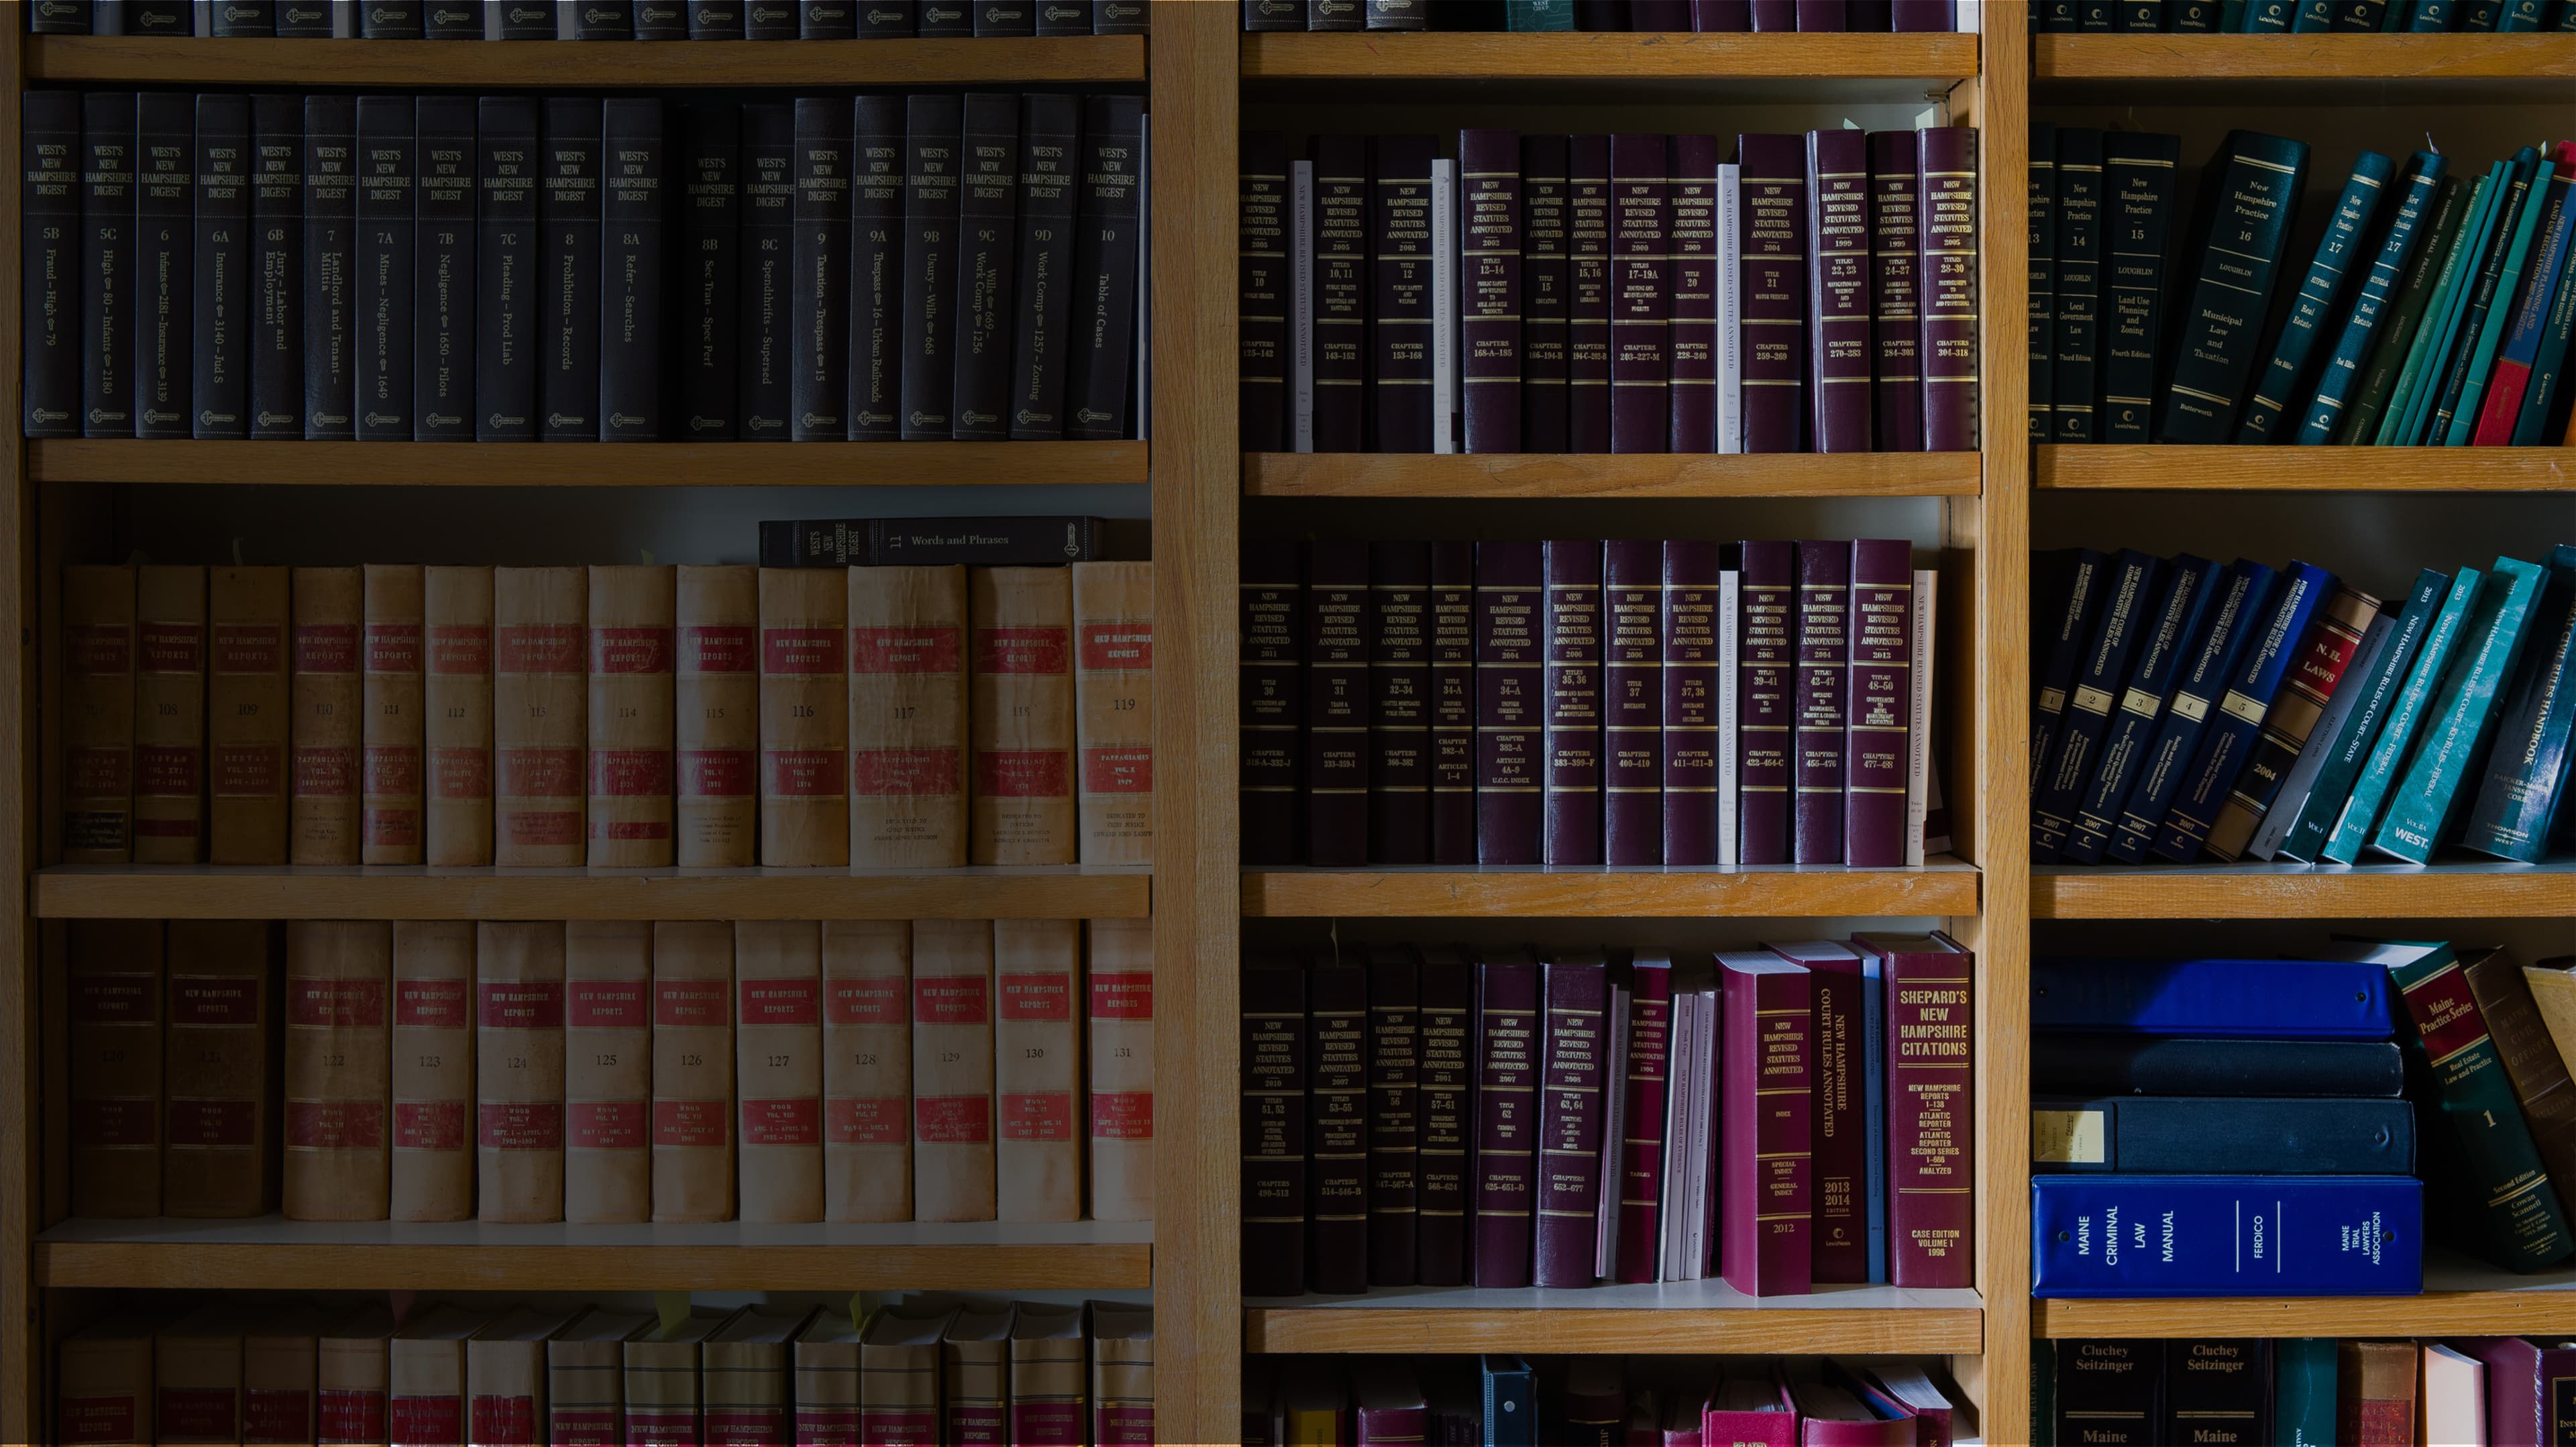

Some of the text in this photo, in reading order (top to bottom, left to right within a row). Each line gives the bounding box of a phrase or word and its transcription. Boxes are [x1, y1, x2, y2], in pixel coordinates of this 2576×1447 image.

[1099, 147, 1128, 159] WEST'S
[1103, 161, 1121, 171] NEW
[1088, 173, 1135, 186] HAMPSHIRE
[2132, 178, 2148, 188] New
[1095, 186, 1125, 198] DIGEST
[1764, 187, 1781, 195] NEW
[2249, 181, 2269, 192] New
[1751, 198, 1793, 206] HAMPSHIRE
[2121, 191, 2158, 203] Hampshire
[2234, 191, 2277, 208] Hampshire
[1758, 209, 1788, 217] REVISED
[2125, 205, 2152, 215] Practice
[2235, 205, 2269, 220] Practice
[1755, 220, 1790, 228] STATUTES
[268, 229, 284, 242] 6B
[501, 233, 516, 246] 7C
[1100, 230, 1115, 242] 10
[1751, 231, 1793, 239] ANNOTATED
[2131, 229, 2144, 239] 15
[2239, 230, 2251, 242] 16
[2328, 242, 2343, 253] 17
[2387, 242, 2402, 252] 17
[2118, 267, 2153, 276] LOUGHLIN
[2219, 263, 2253, 276] LOUGHLIN
[2527, 215, 2565, 329] NEW HAMPSHIRE PLANNING AND
[264, 252, 276, 325] Employment
[1767, 278, 1776, 287] 21
[275, 251, 286, 350] Jury Labor and
[2118, 296, 2150, 306] Land Use
[501, 255, 513, 365] Pleading Prod Liab
[1095, 274, 1109, 348] Table of Cases
[2118, 306, 2149, 317] Planning
[2361, 303, 2375, 315] Real
[2126, 316, 2139, 324] and
[2202, 309, 2243, 327] Municipal
[2354, 315, 2373, 328] Estate
[2121, 325, 2144, 336] Zoning
[2210, 325, 2228, 336] Law
[2208, 339, 2222, 348] and
[2112, 350, 2151, 360] Fourth Edition
[2194, 349, 2229, 365] Taxation
[810, 531, 820, 557] WEST'S
[824, 535, 834, 551] NEW
[836, 523, 846, 564] HAMPSHIRE
[849, 531, 858, 555] DIGEST
[891, 535, 902, 547] 11
[911, 535, 1009, 546] Words and Phrases
[2420, 586, 2432, 602] 2013
[2406, 615, 2419, 633] NEW
[2316, 643, 2328, 655] N.
[2385, 634, 2411, 676] HAMPSHIRE
[2302, 661, 2336, 682] LAWS
[2374, 676, 2390, 700] RULES
[1114, 699, 1135, 710] 119
[2137, 698, 2143, 706] 3
[2370, 698, 2380, 708] OF
[2524, 631, 2571, 765] CIVIL RULES HANDBOOK
[793, 705, 814, 718] 116
[2186, 702, 2192, 710] 4
[2239, 702, 2245, 711] 5
[895, 707, 915, 719] 117
[2254, 764, 2276, 782] 2004
[1900, 990, 1968, 1004] SHEPARD'S
[592, 1007, 623, 1016] REPORTS
[2428, 998, 2455, 1016] Maine
[1920, 1008, 1948, 1021] NEW
[2419, 1002, 2474, 1035] Practice Series
[1901, 1025, 1968, 1038] HAMPSHIRE
[1026, 1049, 1044, 1059] 130
[1901, 1041, 1967, 1055] CITATIONS
[596, 1055, 616, 1066] 125
[682, 1055, 702, 1066] 126
[768, 1055, 790, 1067] 127
[855, 1054, 875, 1065] 128
[942, 1052, 960, 1063] 129
[1821, 988, 1834, 1138] COURT RULES ANNOTATED
[1835, 1014, 1846, 1110] NEW HAMPSHIRE
[2449, 1052, 2481, 1072] Real Estate
[2483, 1110, 2496, 1127] 1
[1825, 1181, 1850, 1193] 2013
[2493, 1169, 2536, 1194] Second Edition
[1825, 1194, 1850, 1205] 2014
[2512, 1194, 2536, 1209] Cowan
[2512, 1201, 2541, 1218] Scannell
[1773, 1224, 1794, 1234] 2012
[1912, 1230, 1960, 1238] CASE EDITION
[2078, 1214, 2090, 1256] MAINE
[2134, 1222, 2145, 1249] LAW
[2106, 1205, 2118, 1267] CRIMINAL
[2162, 1210, 2174, 1263] MANUAL
[2254, 1214, 2263, 1258] FERDICO
[2341, 1225, 2349, 1252] MAINE
[2361, 1220, 2369, 1256] LAWYERS
[2372, 1212, 2381, 1265] ASSOCIATION
[1918, 1239, 1947, 1247] VOLUME
[2082, 1344, 2129, 1358] Cluchey
[2076, 1358, 2134, 1373] Seitzinger
[2083, 1430, 2127, 1444] Maine
